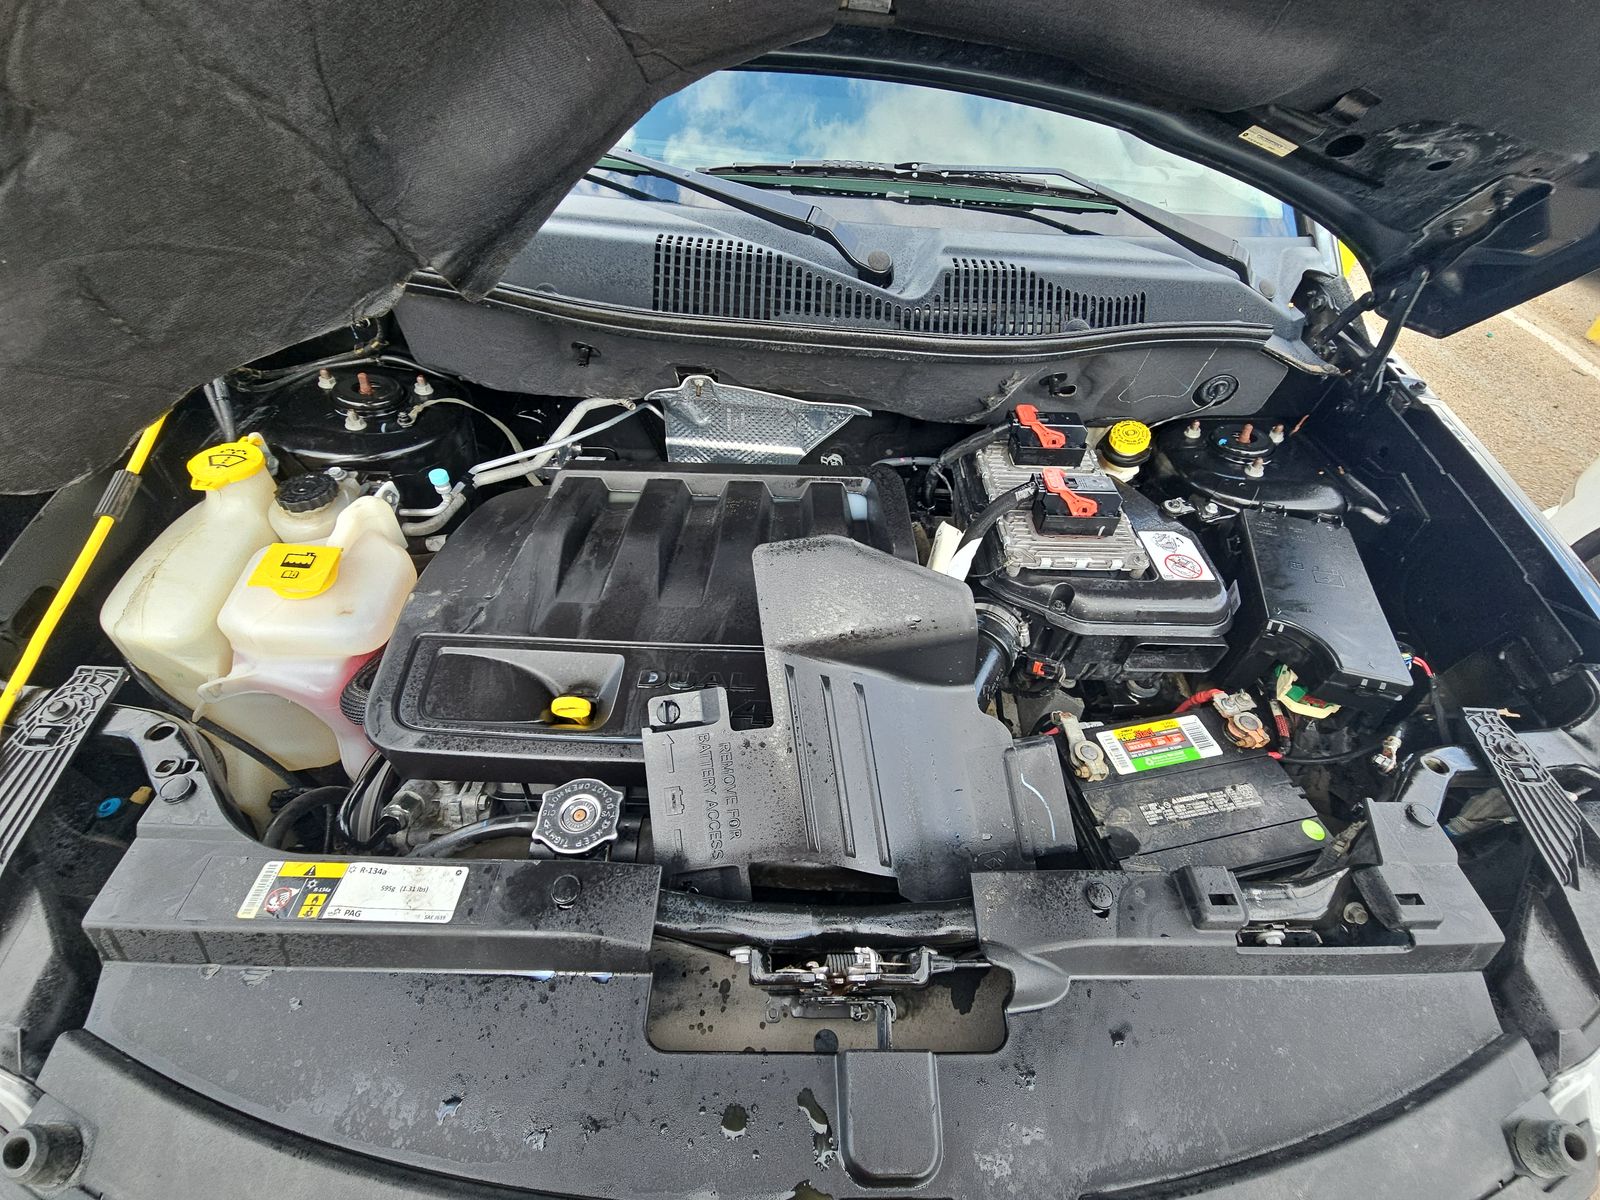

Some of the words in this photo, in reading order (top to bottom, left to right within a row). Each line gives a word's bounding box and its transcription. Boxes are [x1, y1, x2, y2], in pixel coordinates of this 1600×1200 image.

[698, 732, 718, 796] BATTERY
[719, 742, 739, 805] REMOVE
[563, 783, 591, 793] OPEN
[706, 800, 724, 860] ACCESS
[727, 808, 742, 840] FOR
[544, 829, 569, 848] TIGHT
[575, 829, 604, 847] KEEP
[359, 866, 387, 876] R-134a
[343, 909, 362, 918] PAG
